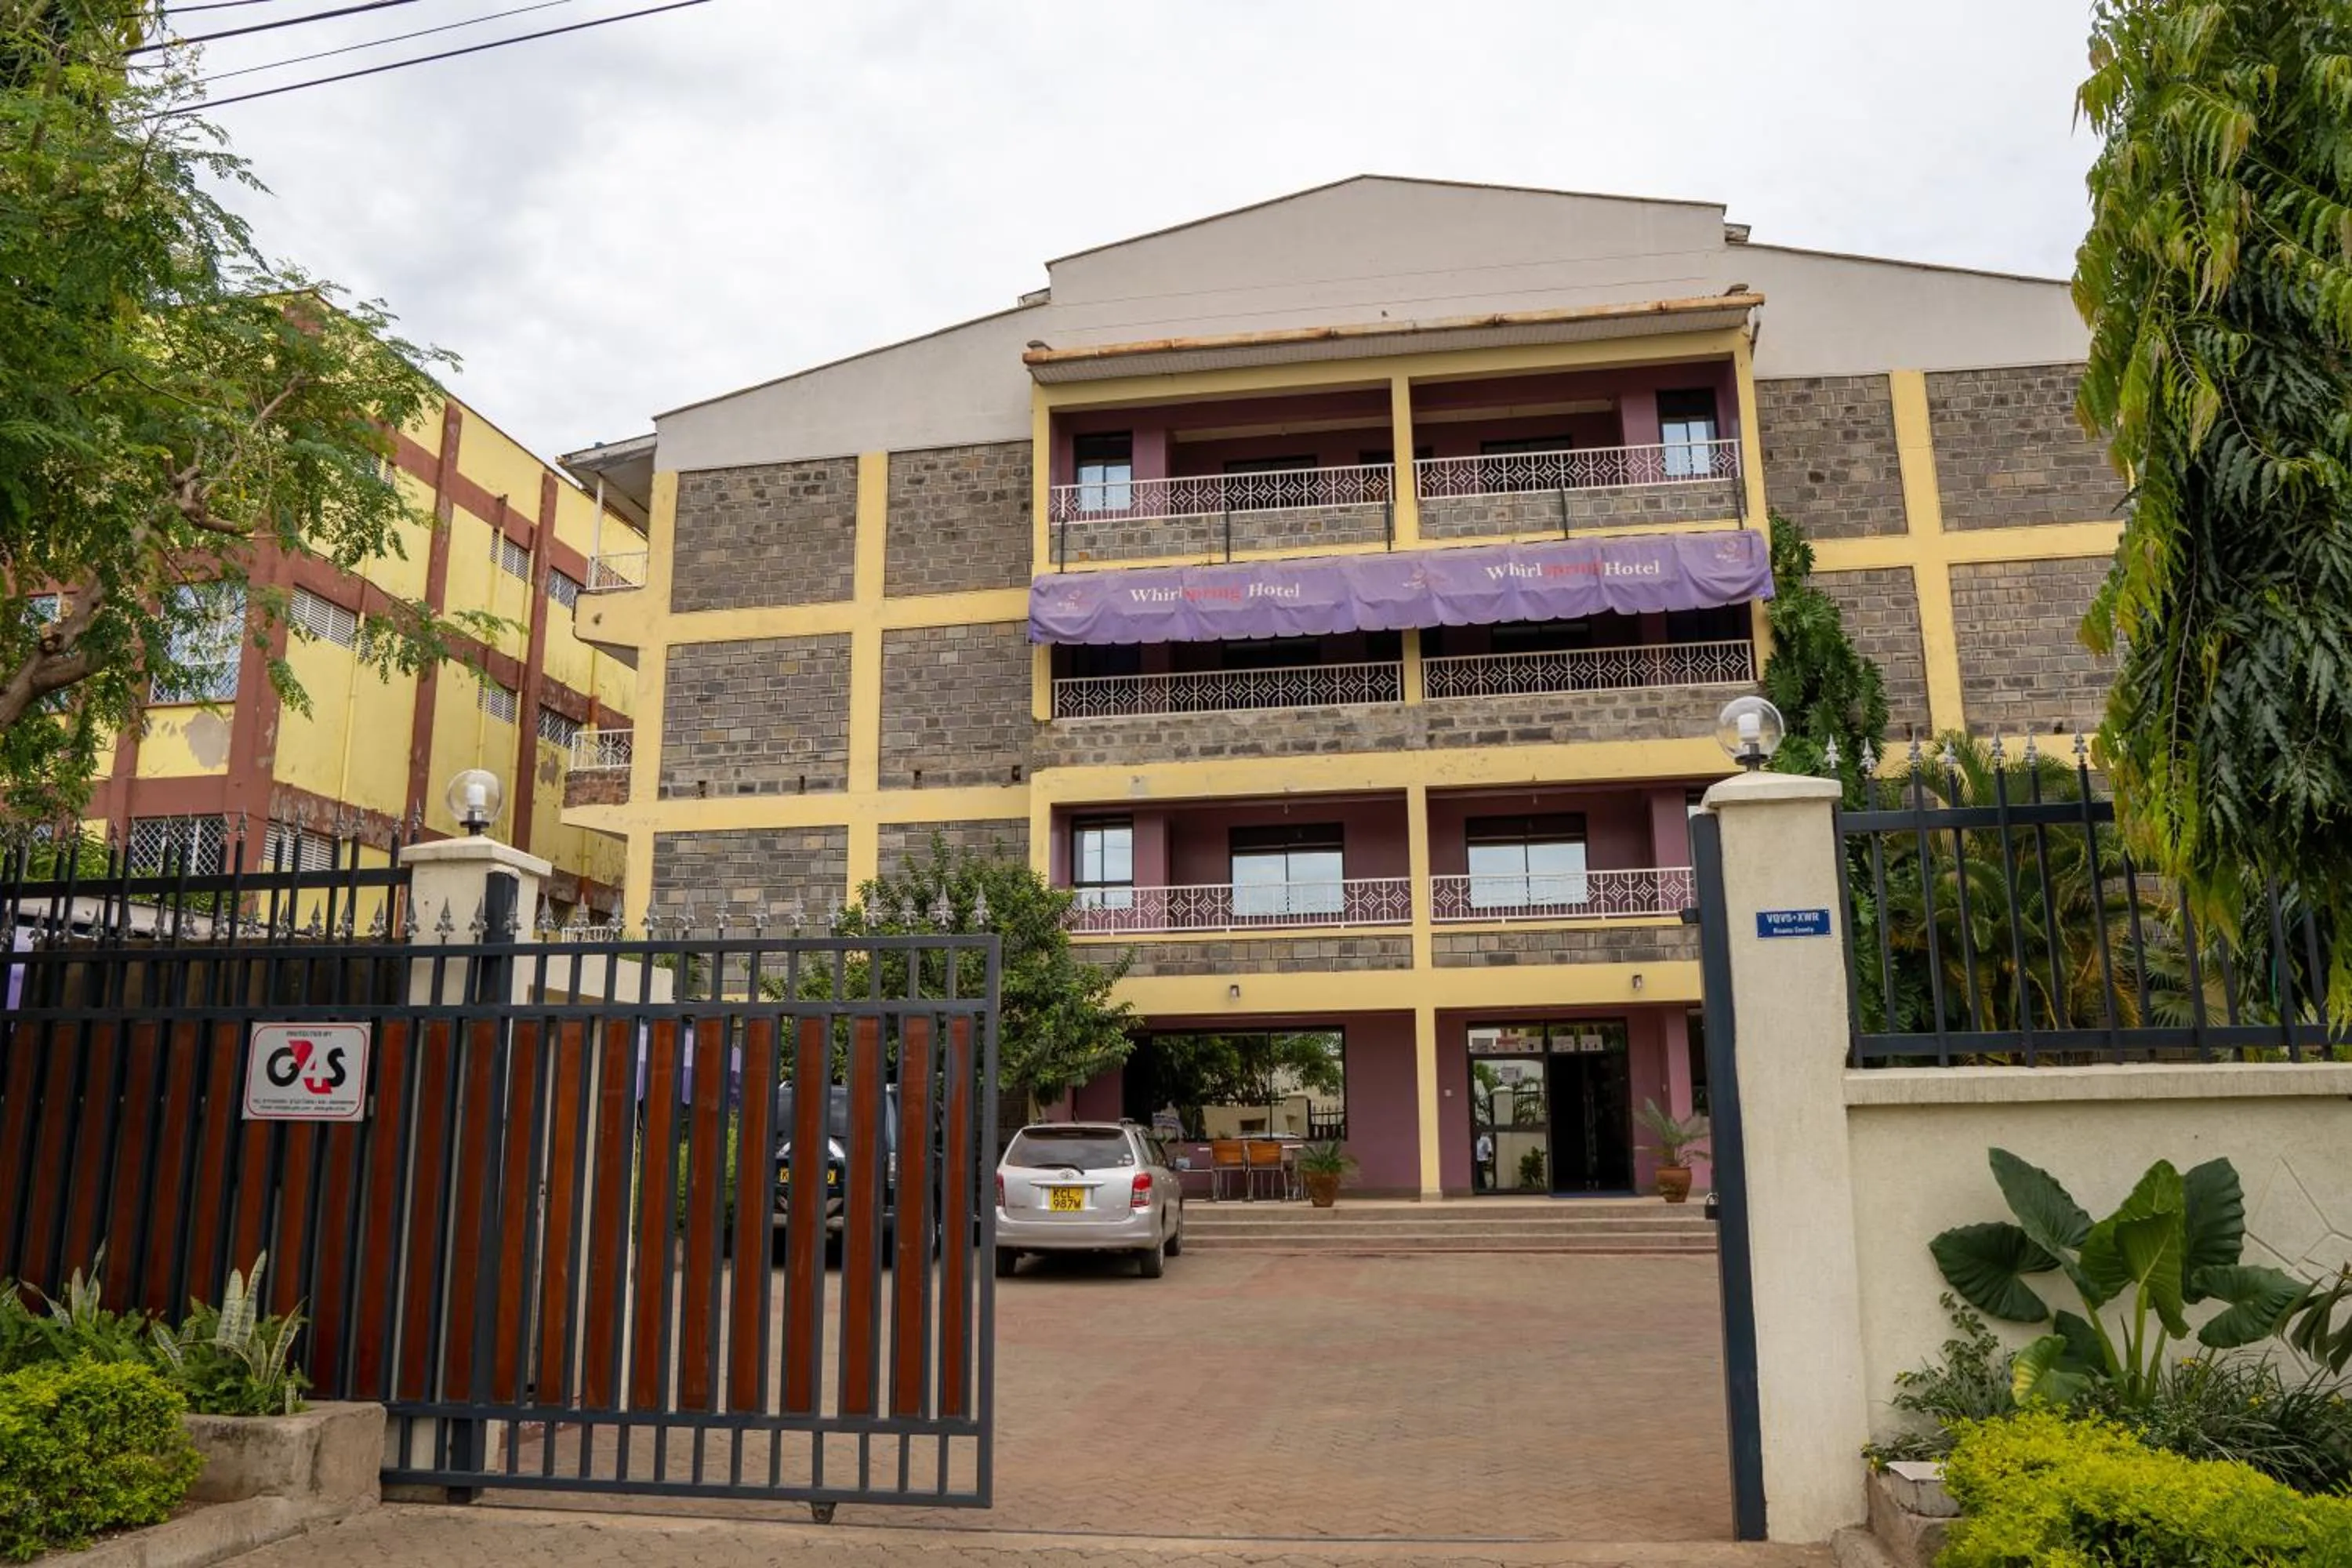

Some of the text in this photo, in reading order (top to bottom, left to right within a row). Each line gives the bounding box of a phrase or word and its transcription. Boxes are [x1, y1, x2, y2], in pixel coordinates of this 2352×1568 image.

[1603, 559, 1660, 575] Hotel
[1248, 583, 1300, 597] Hotel
[267, 1040, 345, 1094] G4S
[1053, 1186, 1074, 1198] KCL
